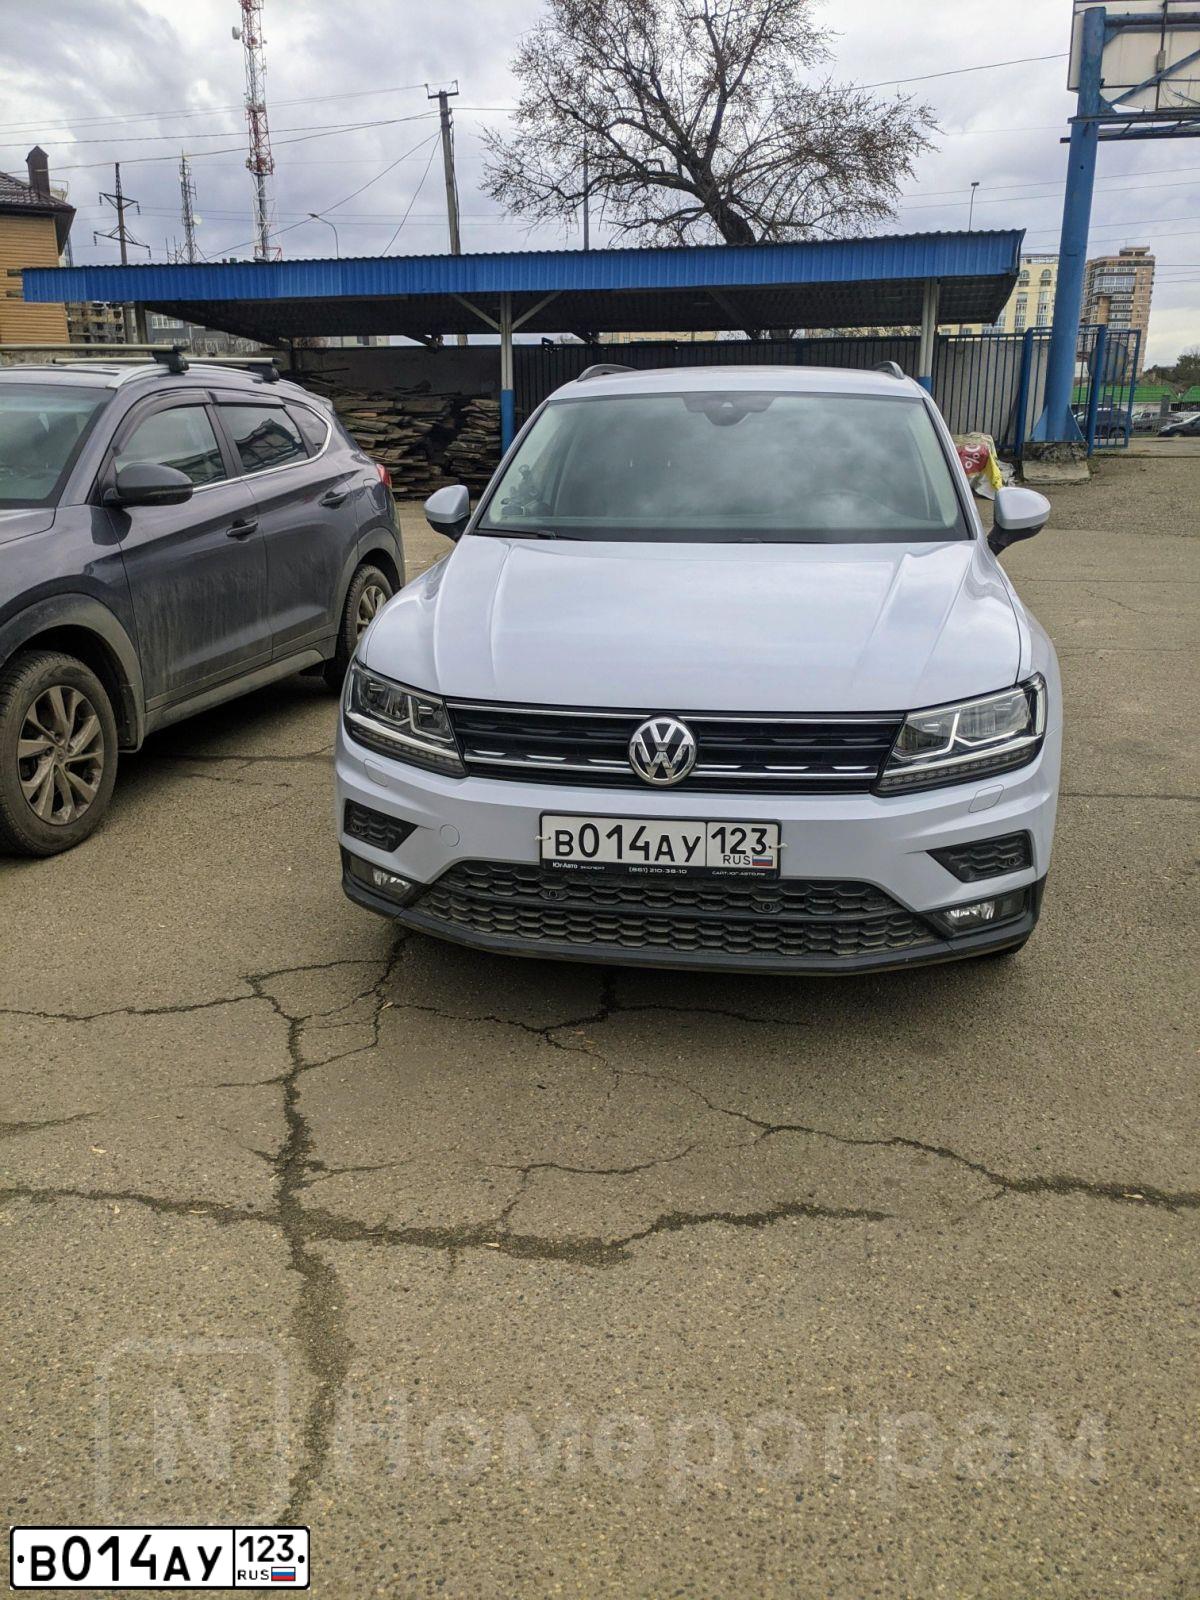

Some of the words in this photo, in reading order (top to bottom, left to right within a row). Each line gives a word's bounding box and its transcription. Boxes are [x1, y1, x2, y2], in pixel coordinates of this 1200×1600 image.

[554, 823, 701, 863] В014АУ
[711, 827, 768, 856] 123
[722, 855, 751, 866] RUS
